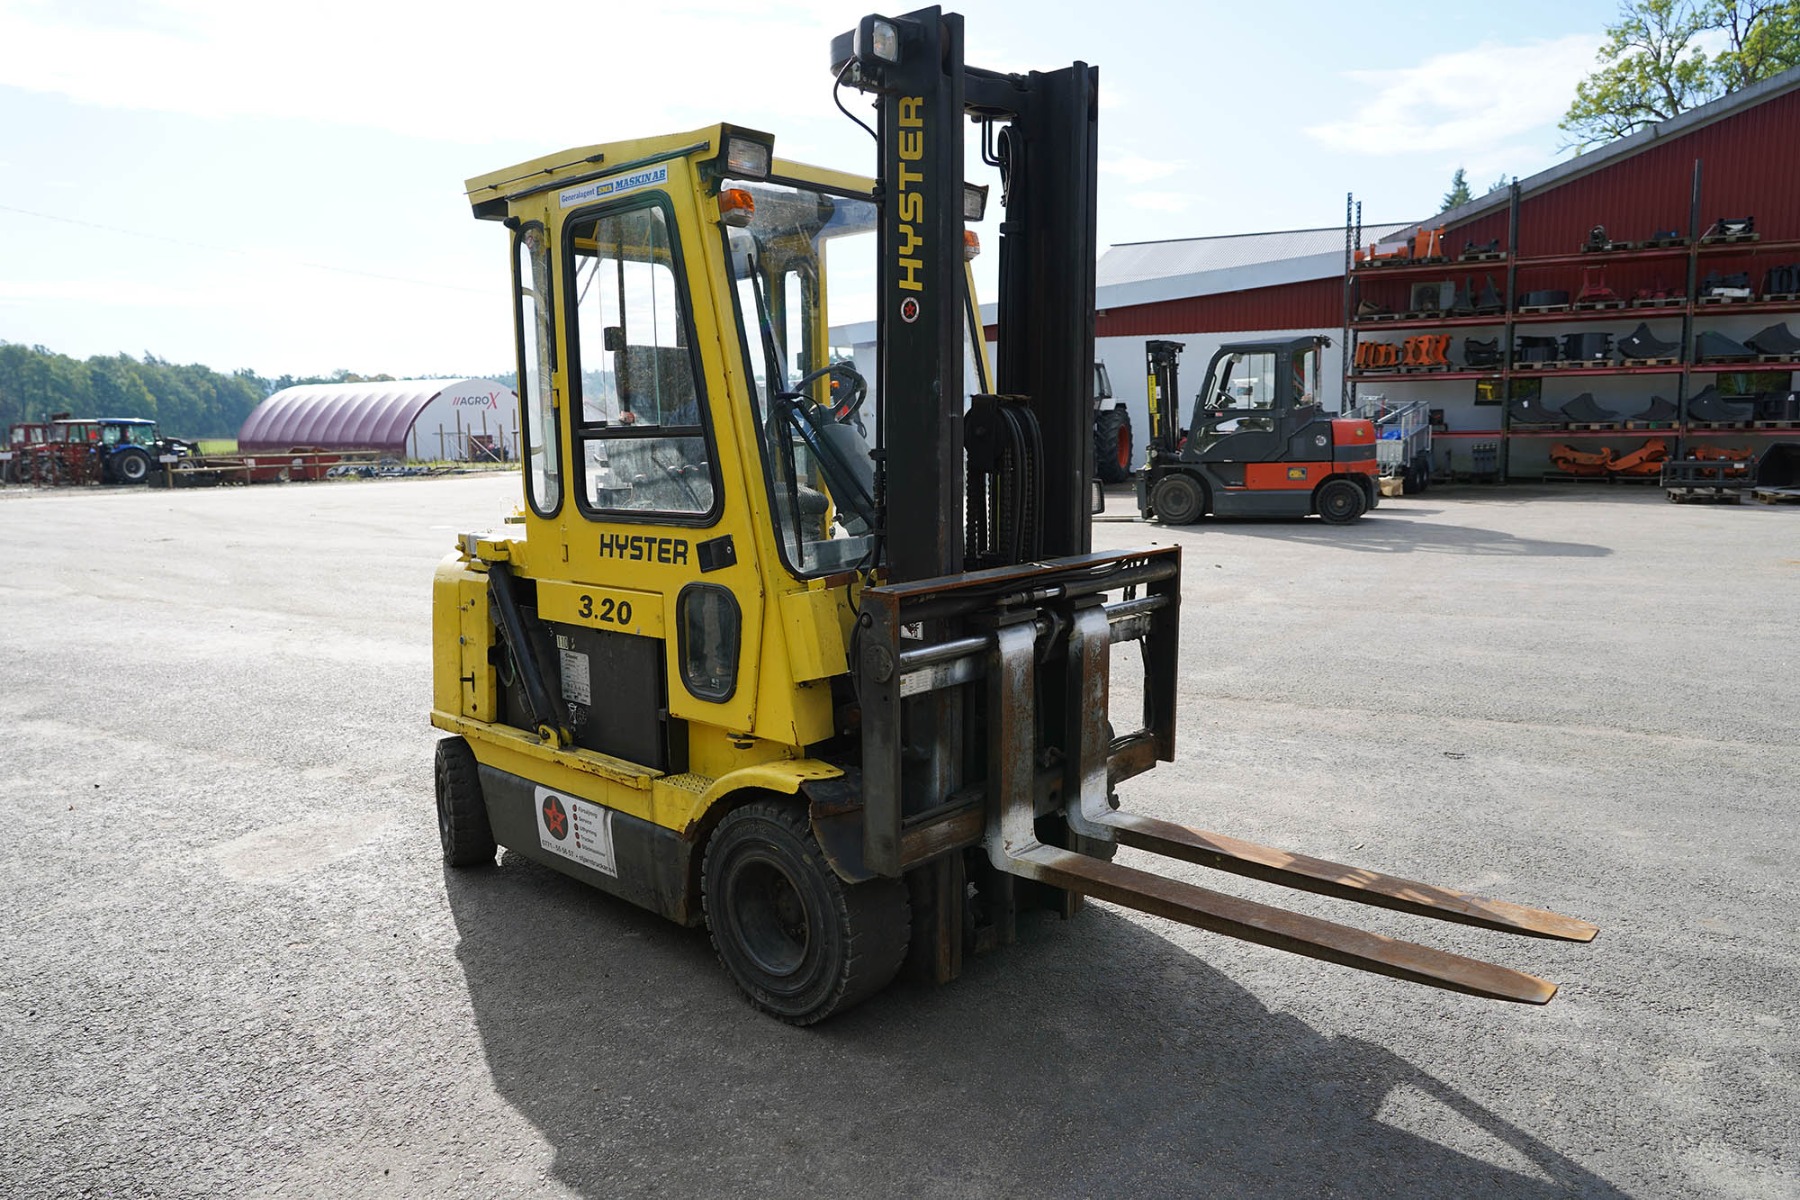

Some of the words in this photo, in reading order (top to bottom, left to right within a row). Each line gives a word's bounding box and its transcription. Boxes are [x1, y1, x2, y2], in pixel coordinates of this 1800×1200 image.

[561, 187, 595, 203] Generalagent
[615, 173, 651, 189] MASKIN
[652, 169, 666, 181] AB
[898, 96, 923, 292] HYSTER
[600, 533, 688, 565] HYSTER
[578, 595, 632, 625] 3.20
